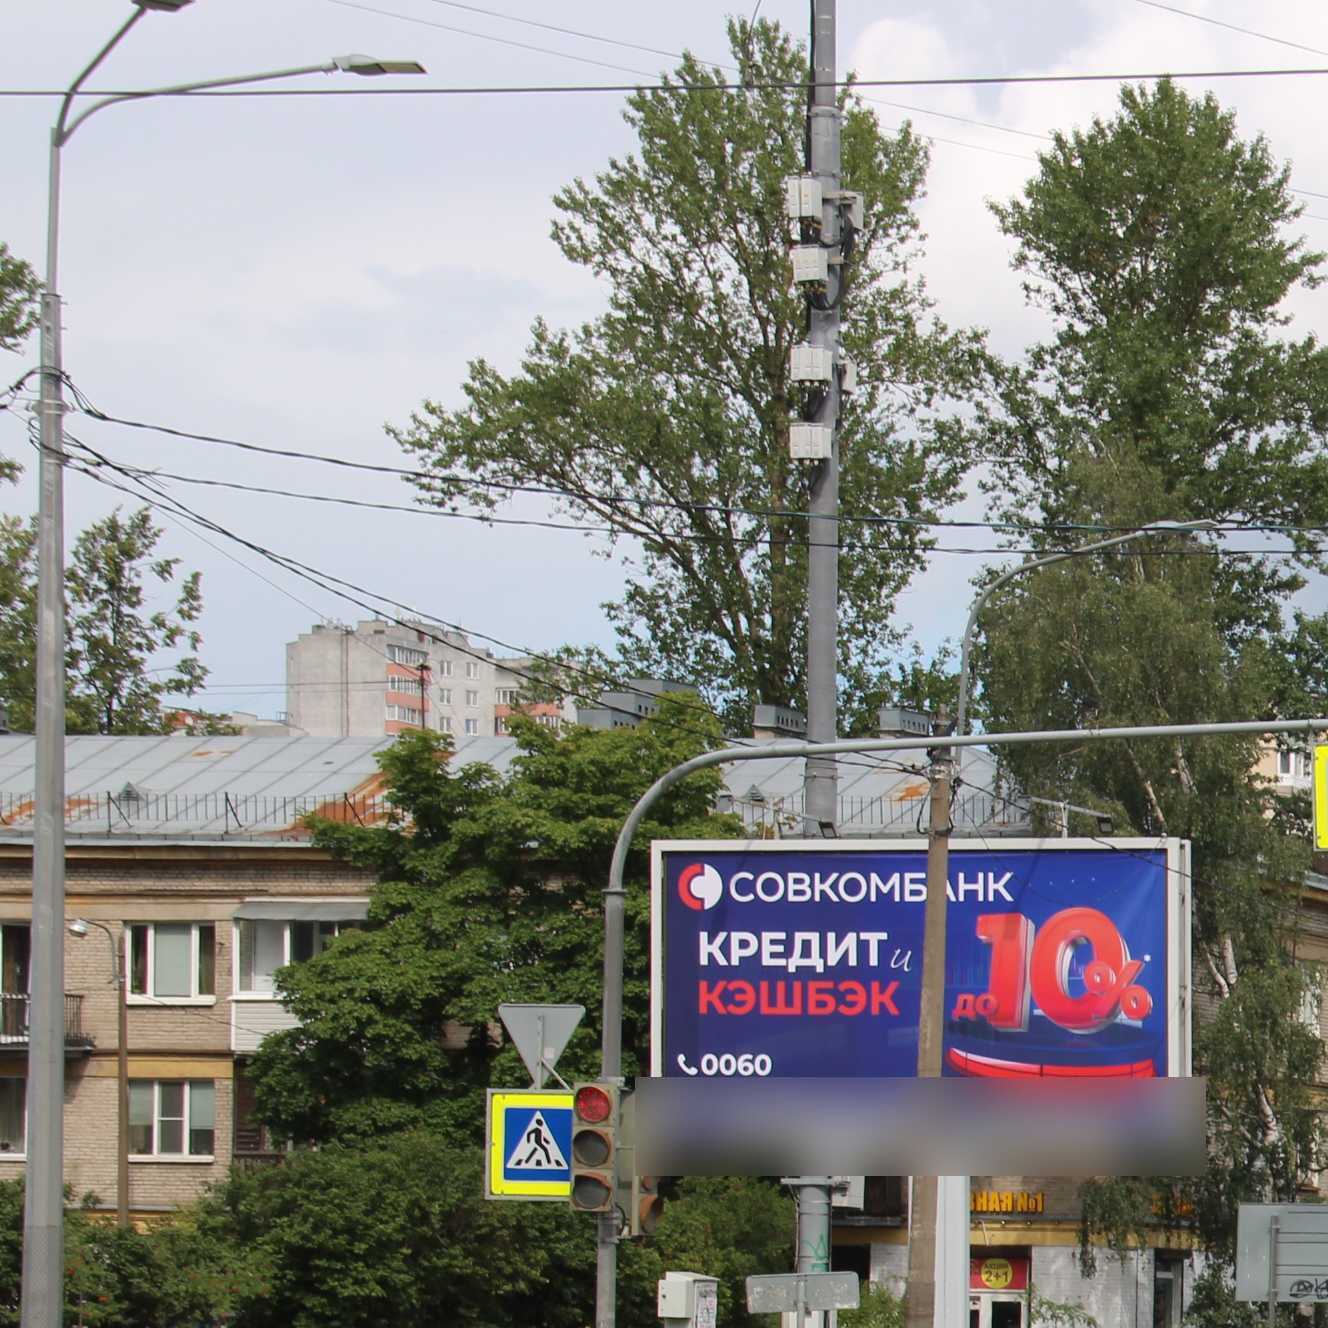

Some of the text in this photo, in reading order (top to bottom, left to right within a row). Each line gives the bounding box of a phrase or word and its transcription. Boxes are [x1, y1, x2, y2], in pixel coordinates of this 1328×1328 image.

[699, 931, 913, 973] КРЕДИТ и
[697, 980, 901, 1016] КЭШБЭК
[952, 993, 998, 1022] до
[700, 1053, 773, 1077] 0060
[970, 1191, 1013, 1213] НАЯ
[984, 1271, 1008, 1282] 2+1
